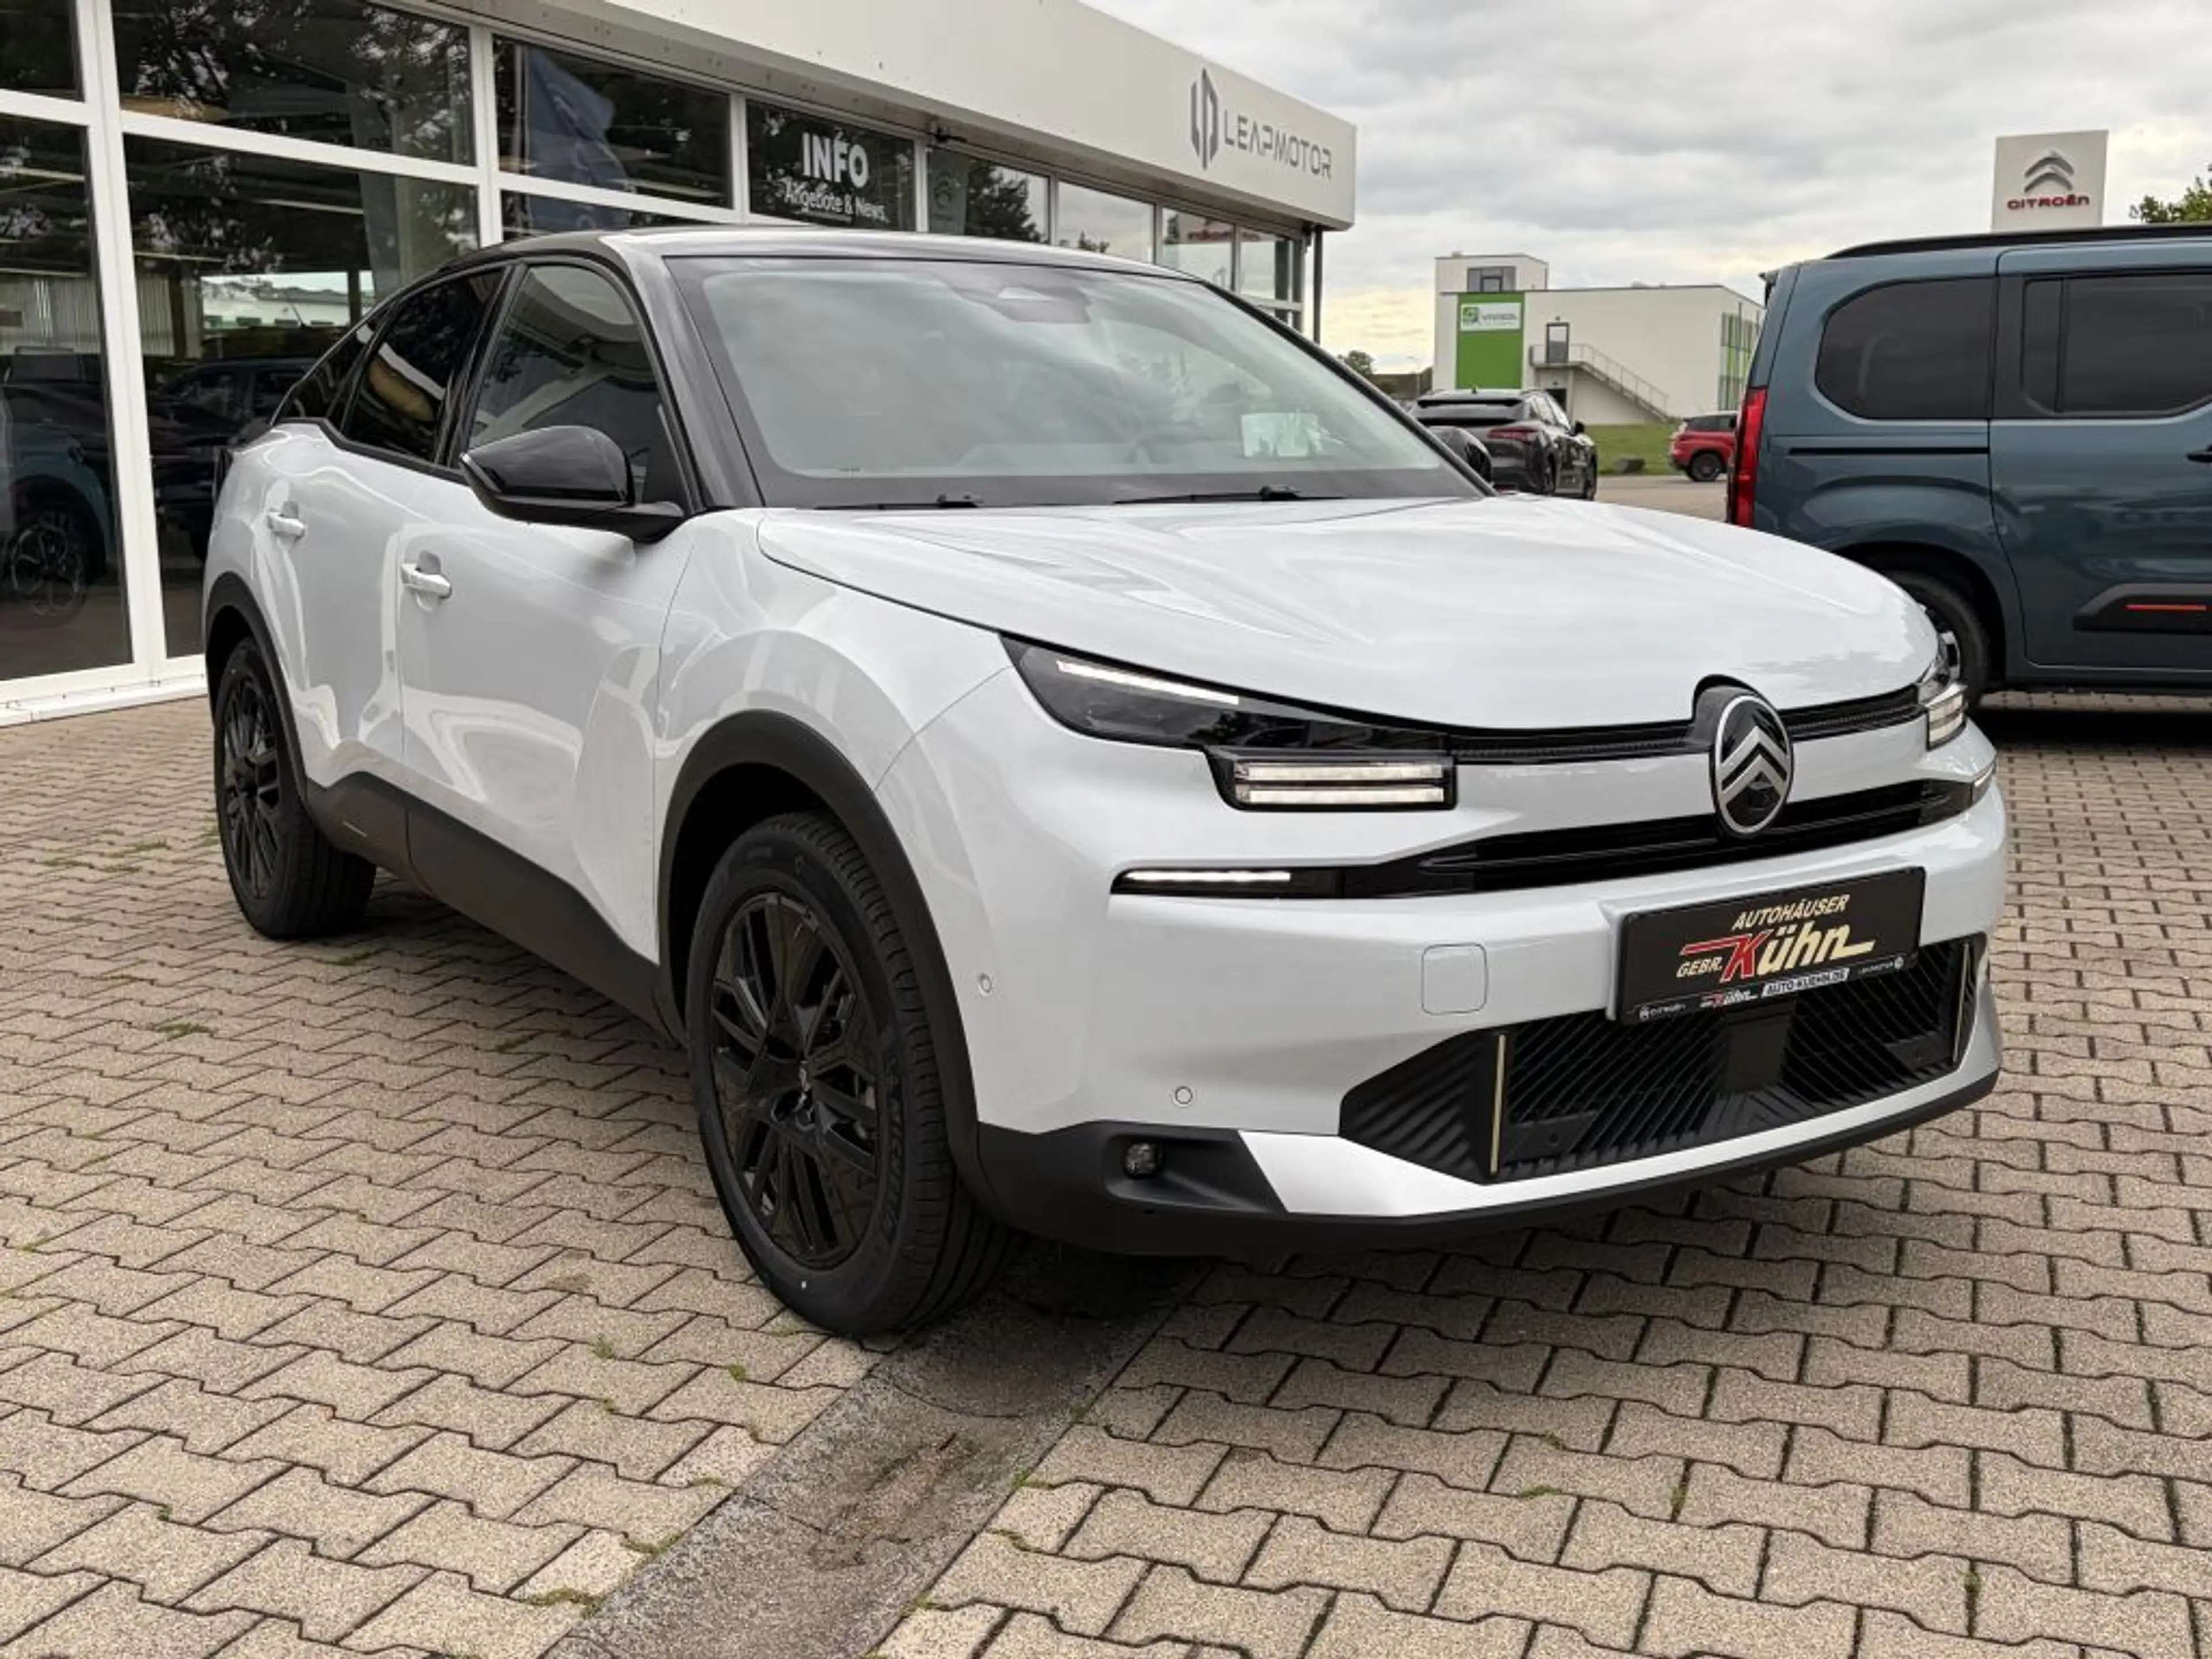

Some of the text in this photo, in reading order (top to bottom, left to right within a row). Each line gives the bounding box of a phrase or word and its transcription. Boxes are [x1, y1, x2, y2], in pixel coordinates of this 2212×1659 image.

[802, 132, 869, 188] INFO
[1224, 109, 1332, 180] LEAPMOTOR
[784, 181, 885, 221] Angebote & News
[1731, 894, 1850, 931] AUTOHÄUSER
[1676, 921, 1875, 983] GEBR. Kühn
